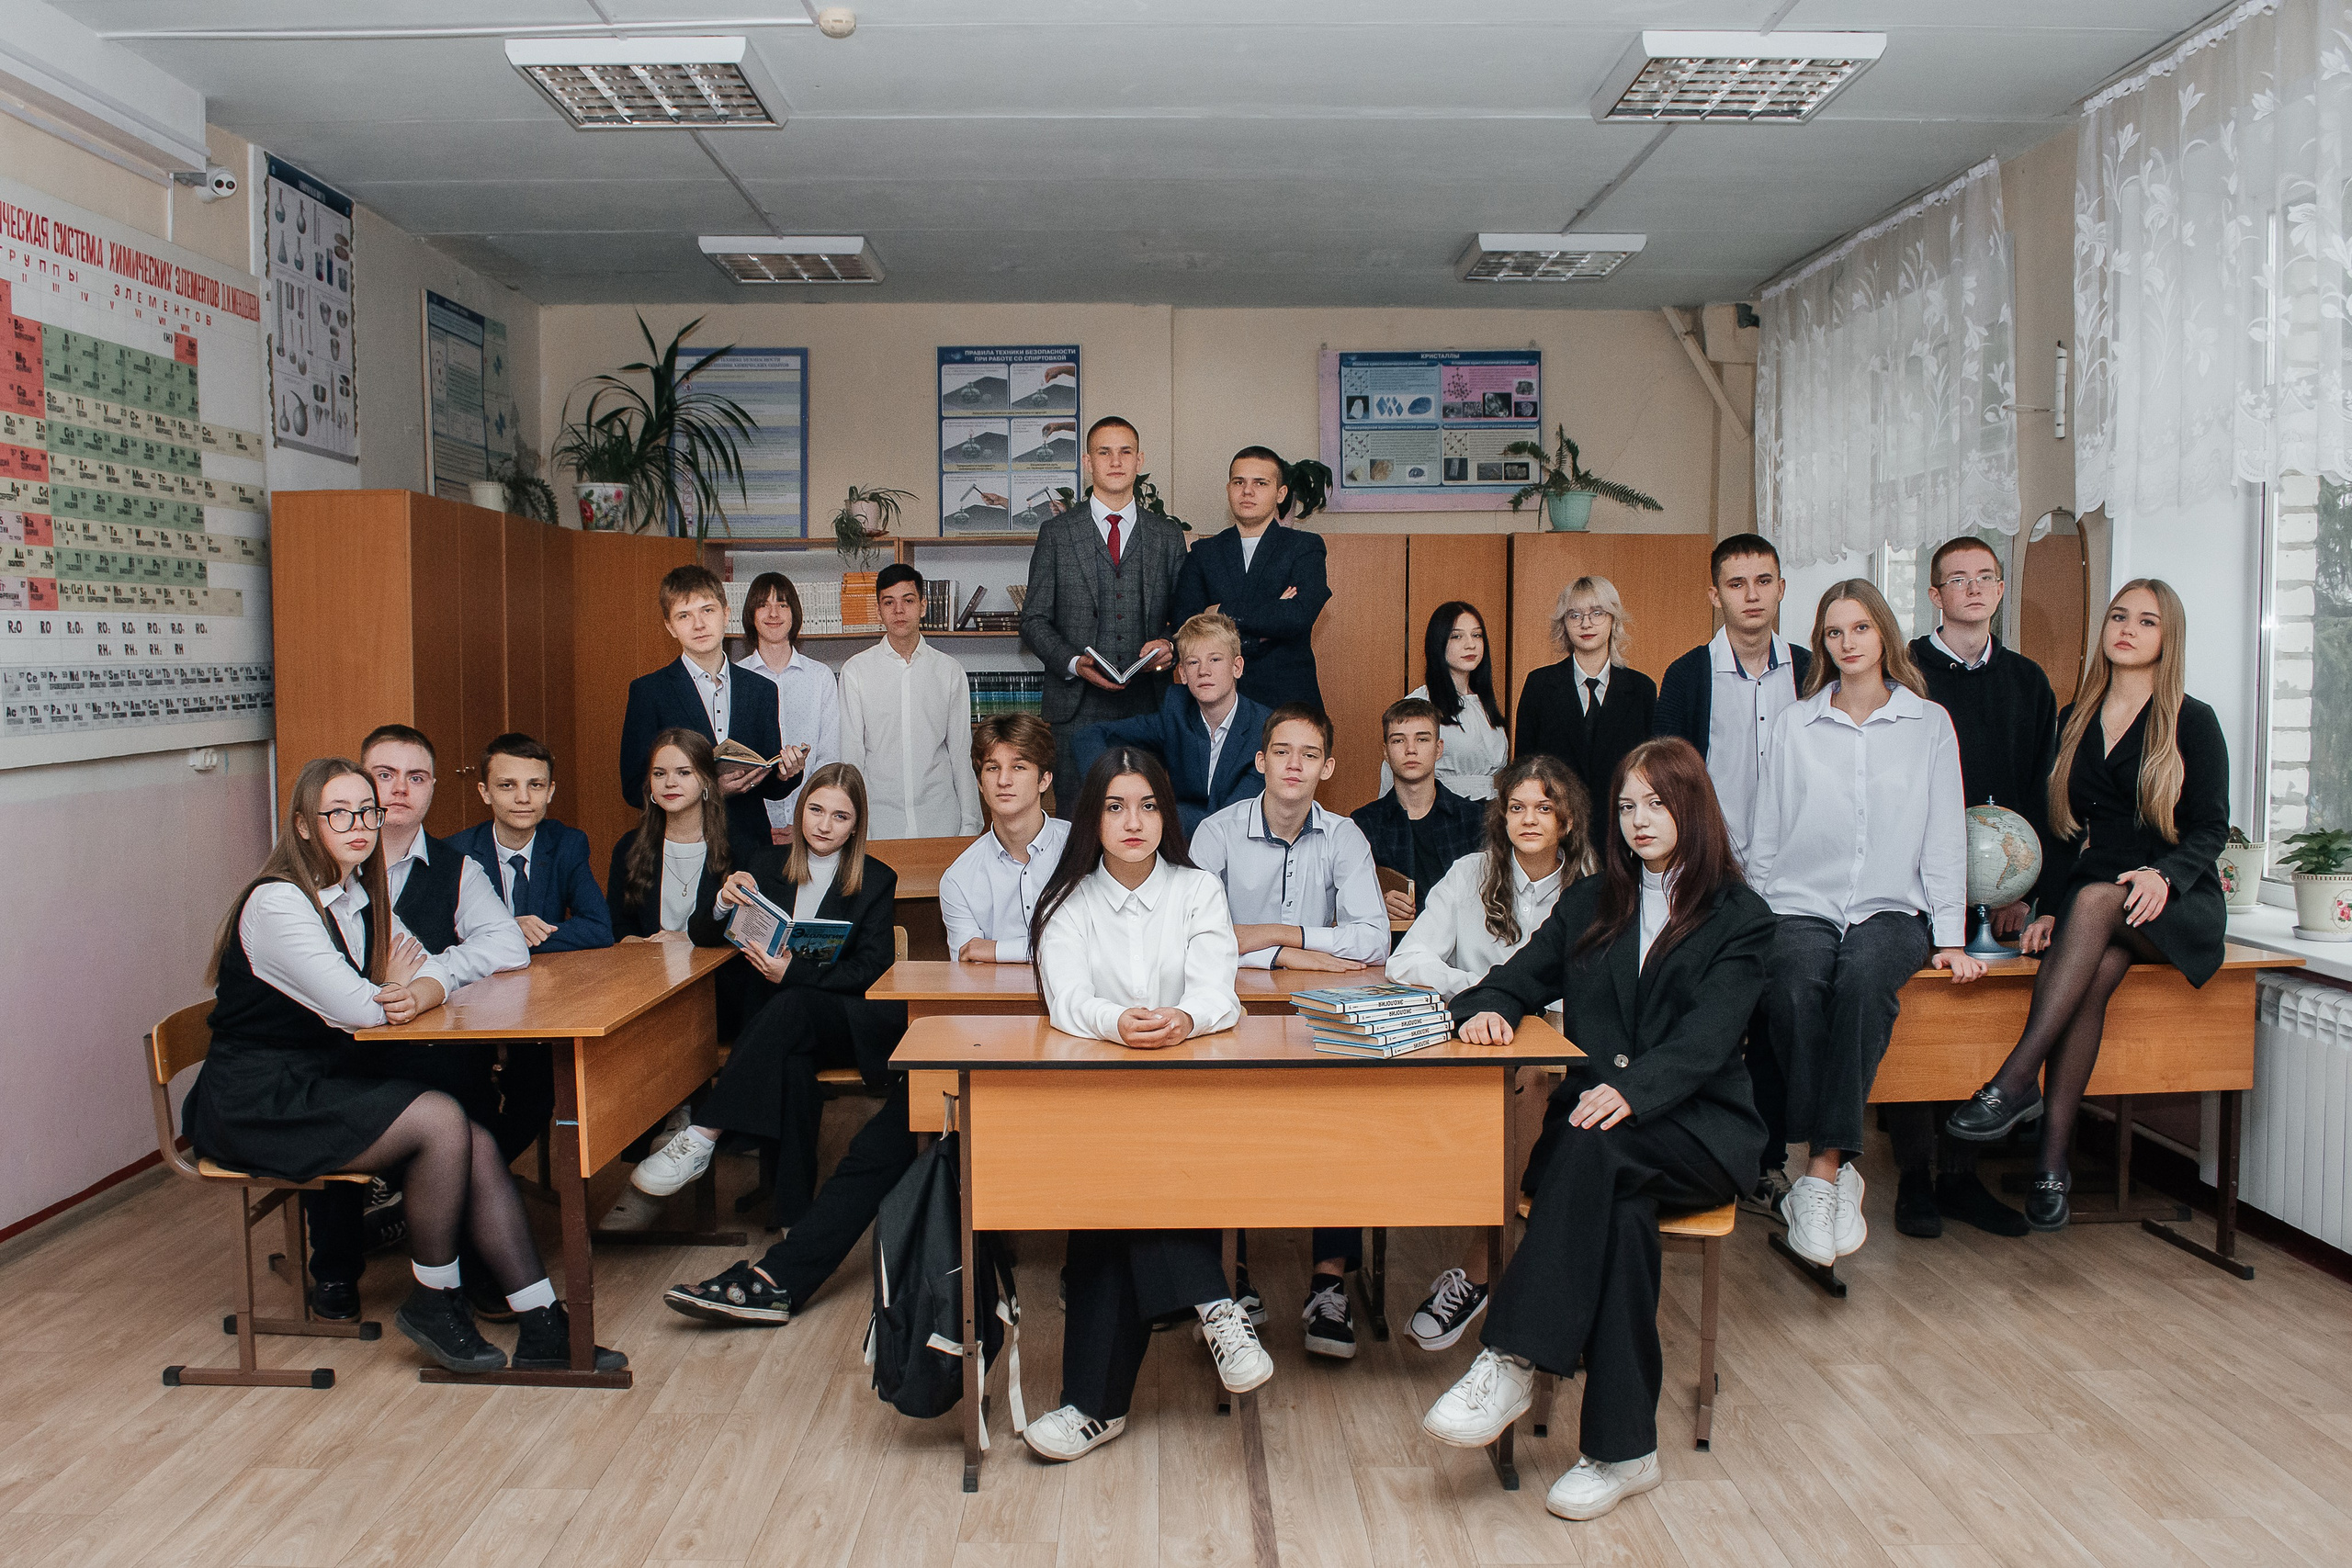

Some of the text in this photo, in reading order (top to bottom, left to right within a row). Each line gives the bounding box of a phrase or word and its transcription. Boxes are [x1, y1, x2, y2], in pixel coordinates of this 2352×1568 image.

[0, 199, 49, 250] ЧЕСКАЯ
[53, 220, 104, 269] СИСТЕМА
[108, 241, 173, 292] ХИМИЧЕСКИХ
[175, 265, 220, 309] ЭЛЕМЕНТОВ
[81, 291, 89, 302] IV
[109, 300, 115, 310] V
[134, 308, 141, 319] VI
[14, 319, 24, 332] Be
[158, 316, 166, 326] VII
[17, 385, 27, 398] Ca
[47, 391, 57, 404] Sc
[75, 398, 84, 410] Ti
[103, 404, 108, 416] V
[130, 411, 139, 422] Cr
[154, 416, 165, 427] Mn
[36, 421, 45, 433] Zn
[178, 421, 186, 432] Fe
[201, 426, 211, 437] Co
[20, 450, 29, 462] Sr
[79, 460, 88, 471] Zr
[106, 465, 116, 476] Nb
[131, 469, 143, 481] Mo
[158, 474, 166, 484] Tc
[11, 482, 20, 497] Ag
[39, 486, 49, 498] Cd
[96, 494, 106, 505] Sn
[109, 525, 118, 536] Ta
[15, 547, 24, 559] Au
[99, 555, 109, 566] Pb
[40, 620, 51, 634] RO
[175, 643, 184, 655] RH
[26, 671, 38, 683] Ce
[49, 671, 58, 682] Pr
[69, 671, 80, 682] Nd
[89, 671, 101, 681] Pm
[108, 670, 119, 681] Sm
[127, 670, 136, 680] Eu
[51, 704, 62, 715] Pa
[72, 703, 78, 714] U
[111, 701, 120, 712] Pu
[130, 700, 141, 710] Am
[148, 699, 159, 709] Cm
[6, 706, 17, 717] Ac
[28, 705, 39, 716] Th
[792, 928, 844, 940] Экология
[1378, 998, 1404, 1008] ЭКОЛОГИЯ
[1388, 1008, 1412, 1017] ЭКОЛОГИЯ
[1401, 1018, 1423, 1027] ЭКОЛОГИЯ
[1410, 1027, 1430, 1037] ЭКОЛОГИЯ
[1413, 1039, 1430, 1049] ЭКОЛОГИЯ
